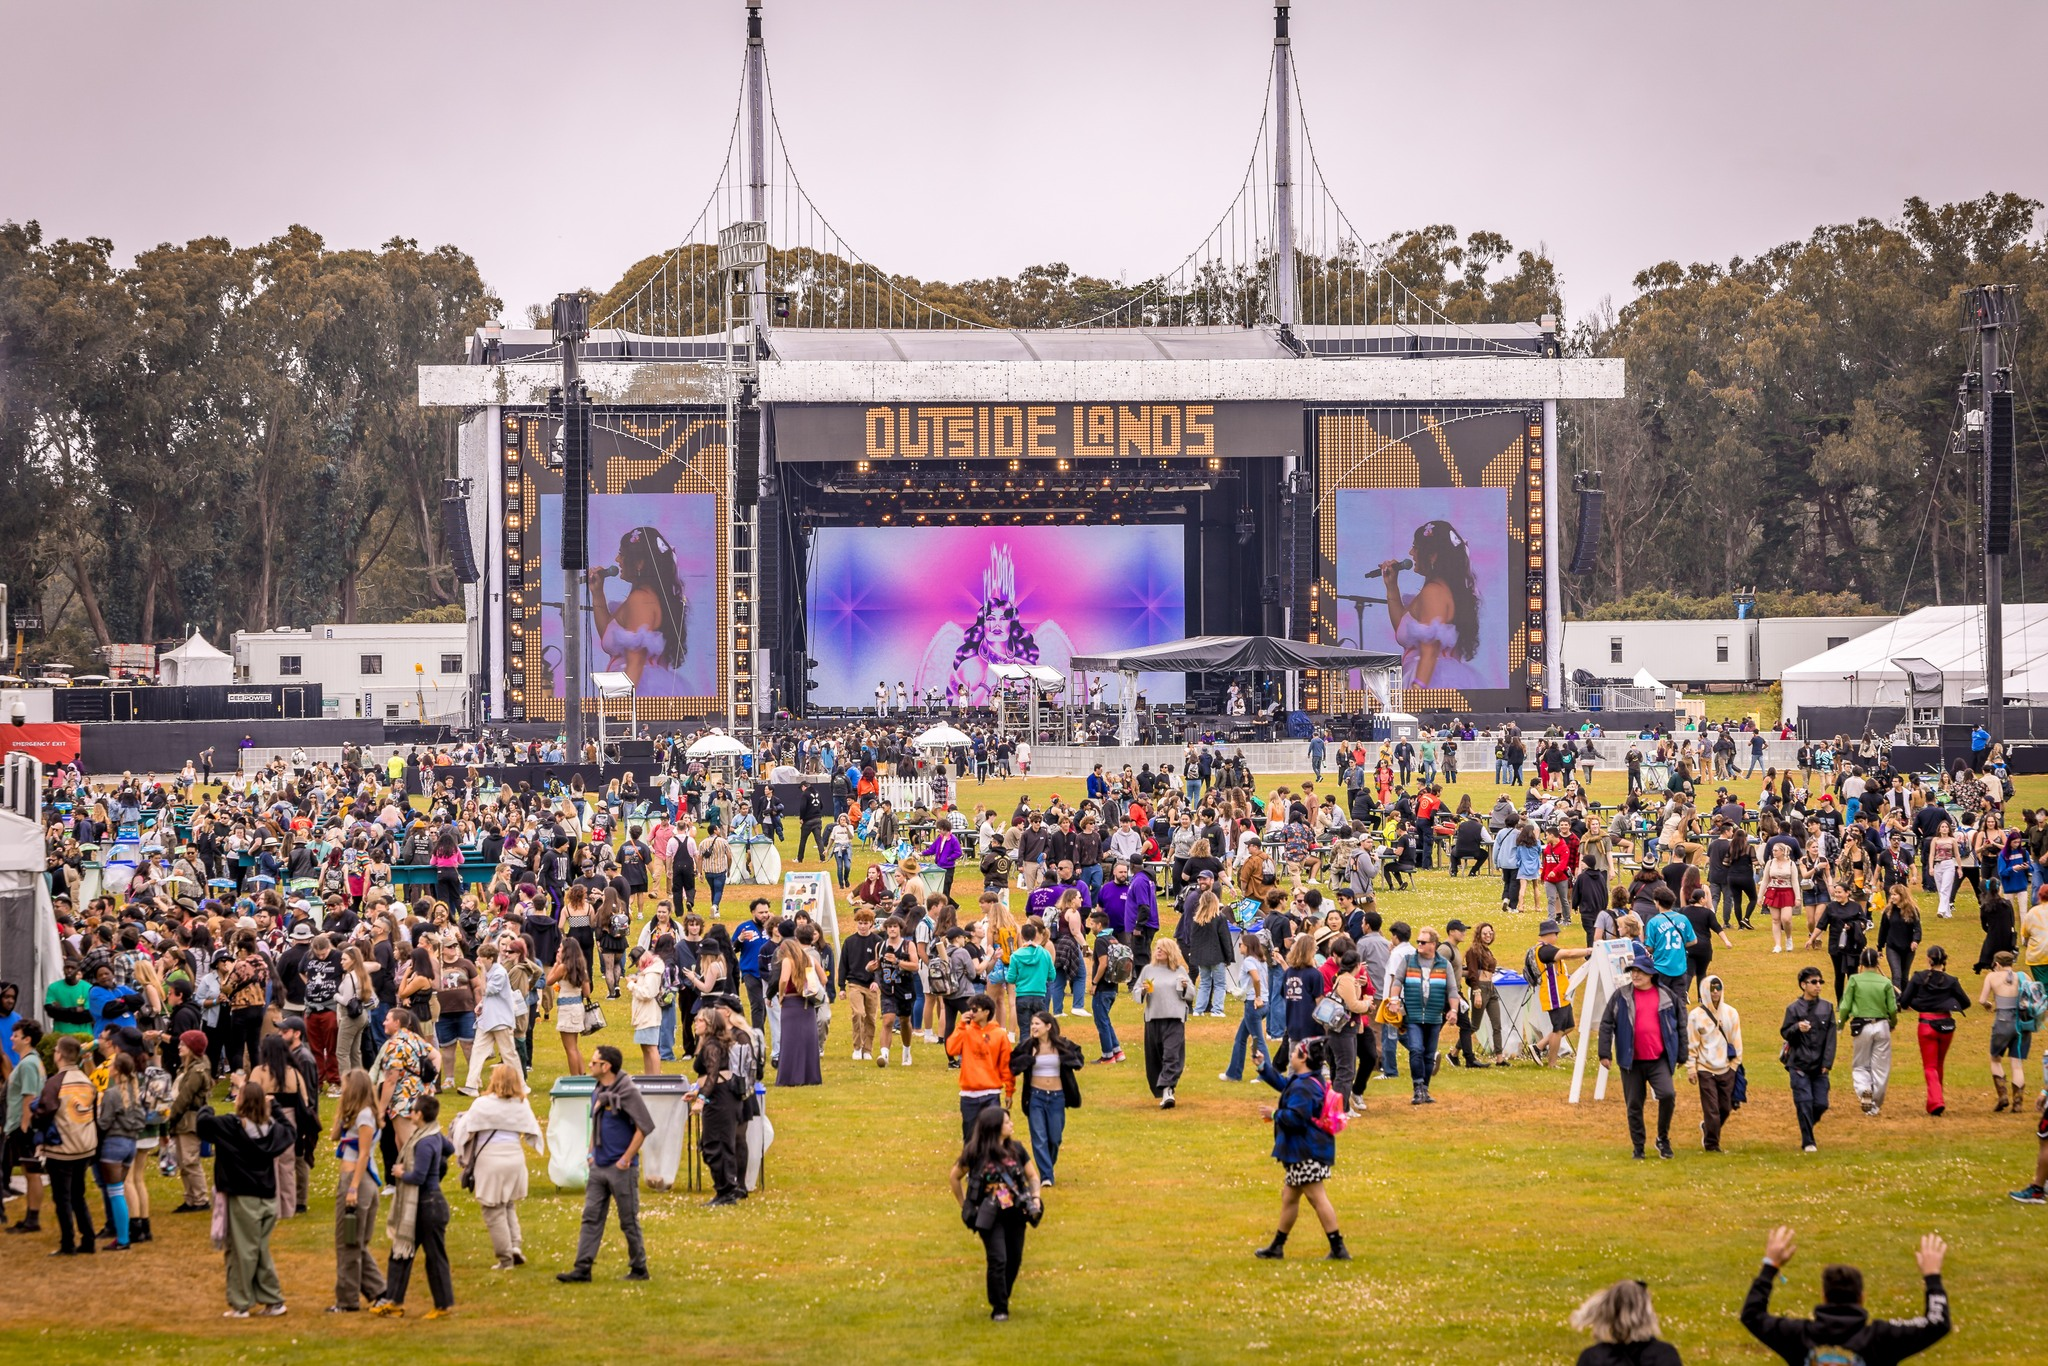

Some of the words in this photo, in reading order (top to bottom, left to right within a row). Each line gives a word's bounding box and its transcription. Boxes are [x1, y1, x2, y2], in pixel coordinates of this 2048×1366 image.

[865, 406, 1056, 458] OUTSIDE
[1073, 405, 1215, 457] LANDS
[1665, 929, 1682, 950] 13
[883, 968, 902, 984] 24
